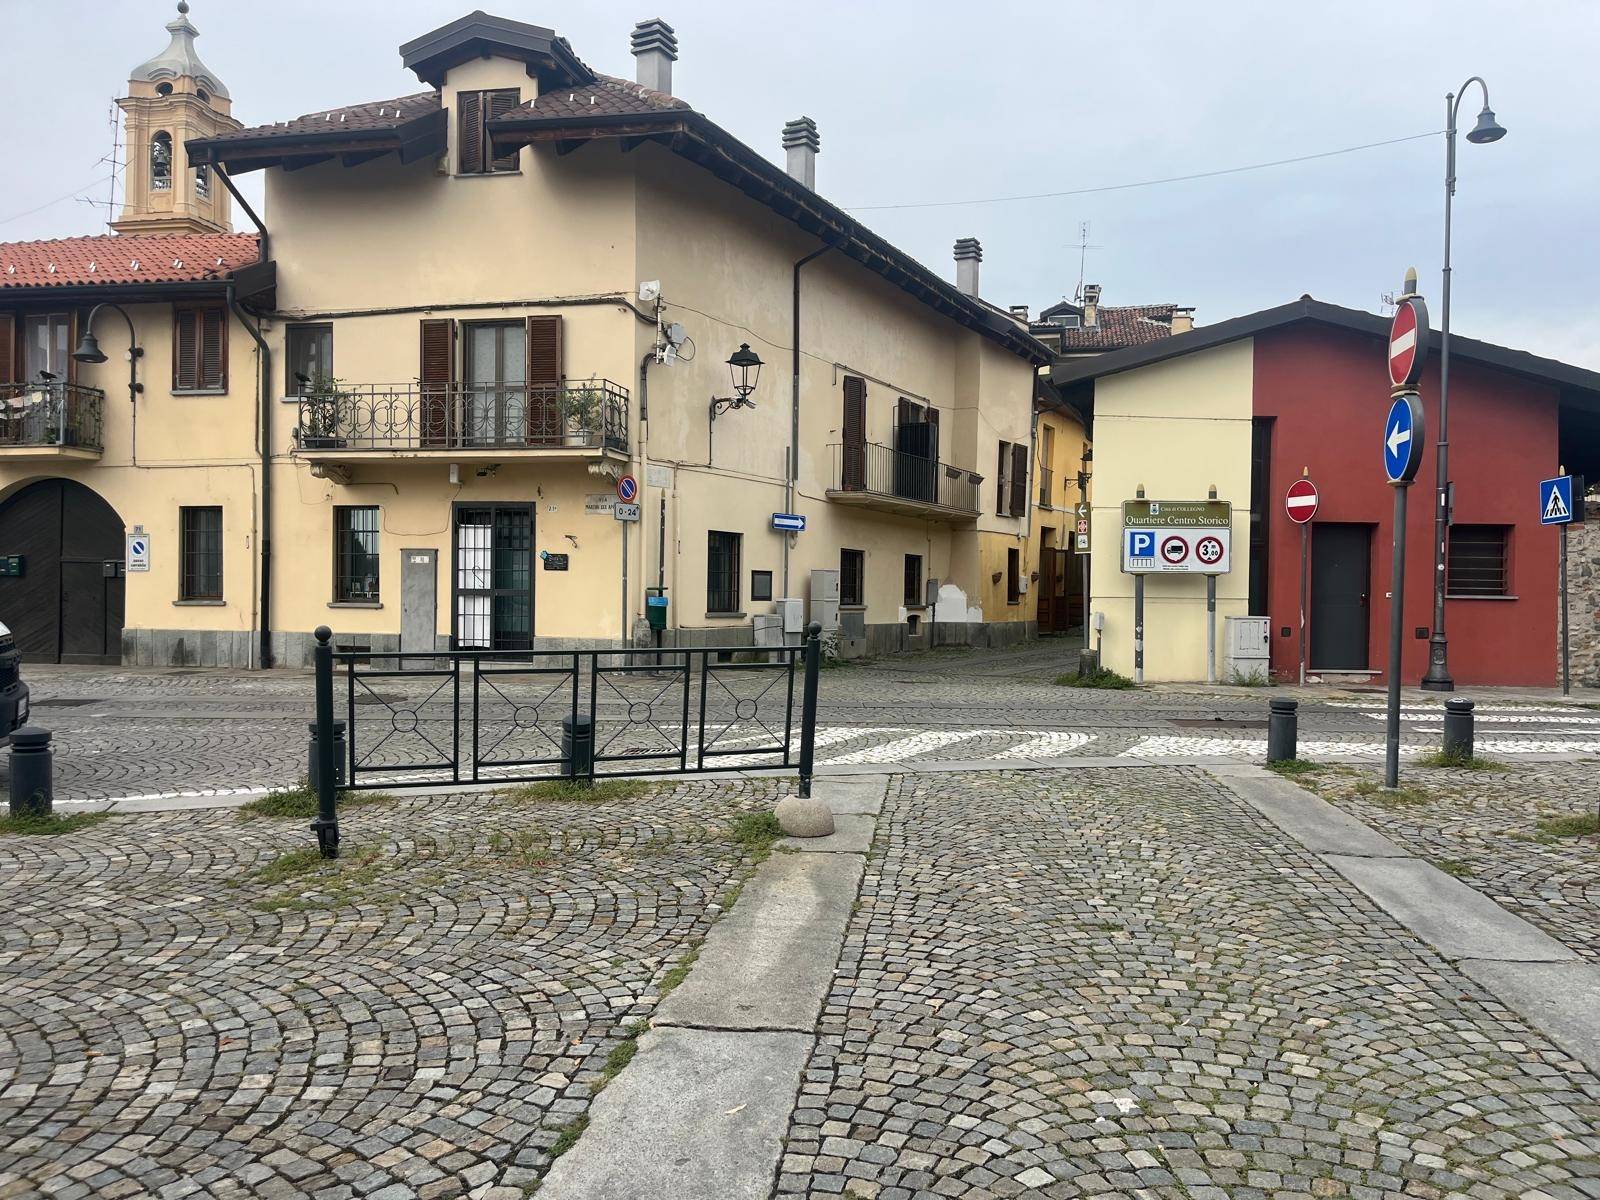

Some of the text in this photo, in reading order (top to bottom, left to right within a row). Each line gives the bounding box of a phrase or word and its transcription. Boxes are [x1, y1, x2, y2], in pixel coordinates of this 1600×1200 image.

[1126, 515, 1229, 525] Quartiere Centro Storico
[1134, 534, 1151, 555] P
